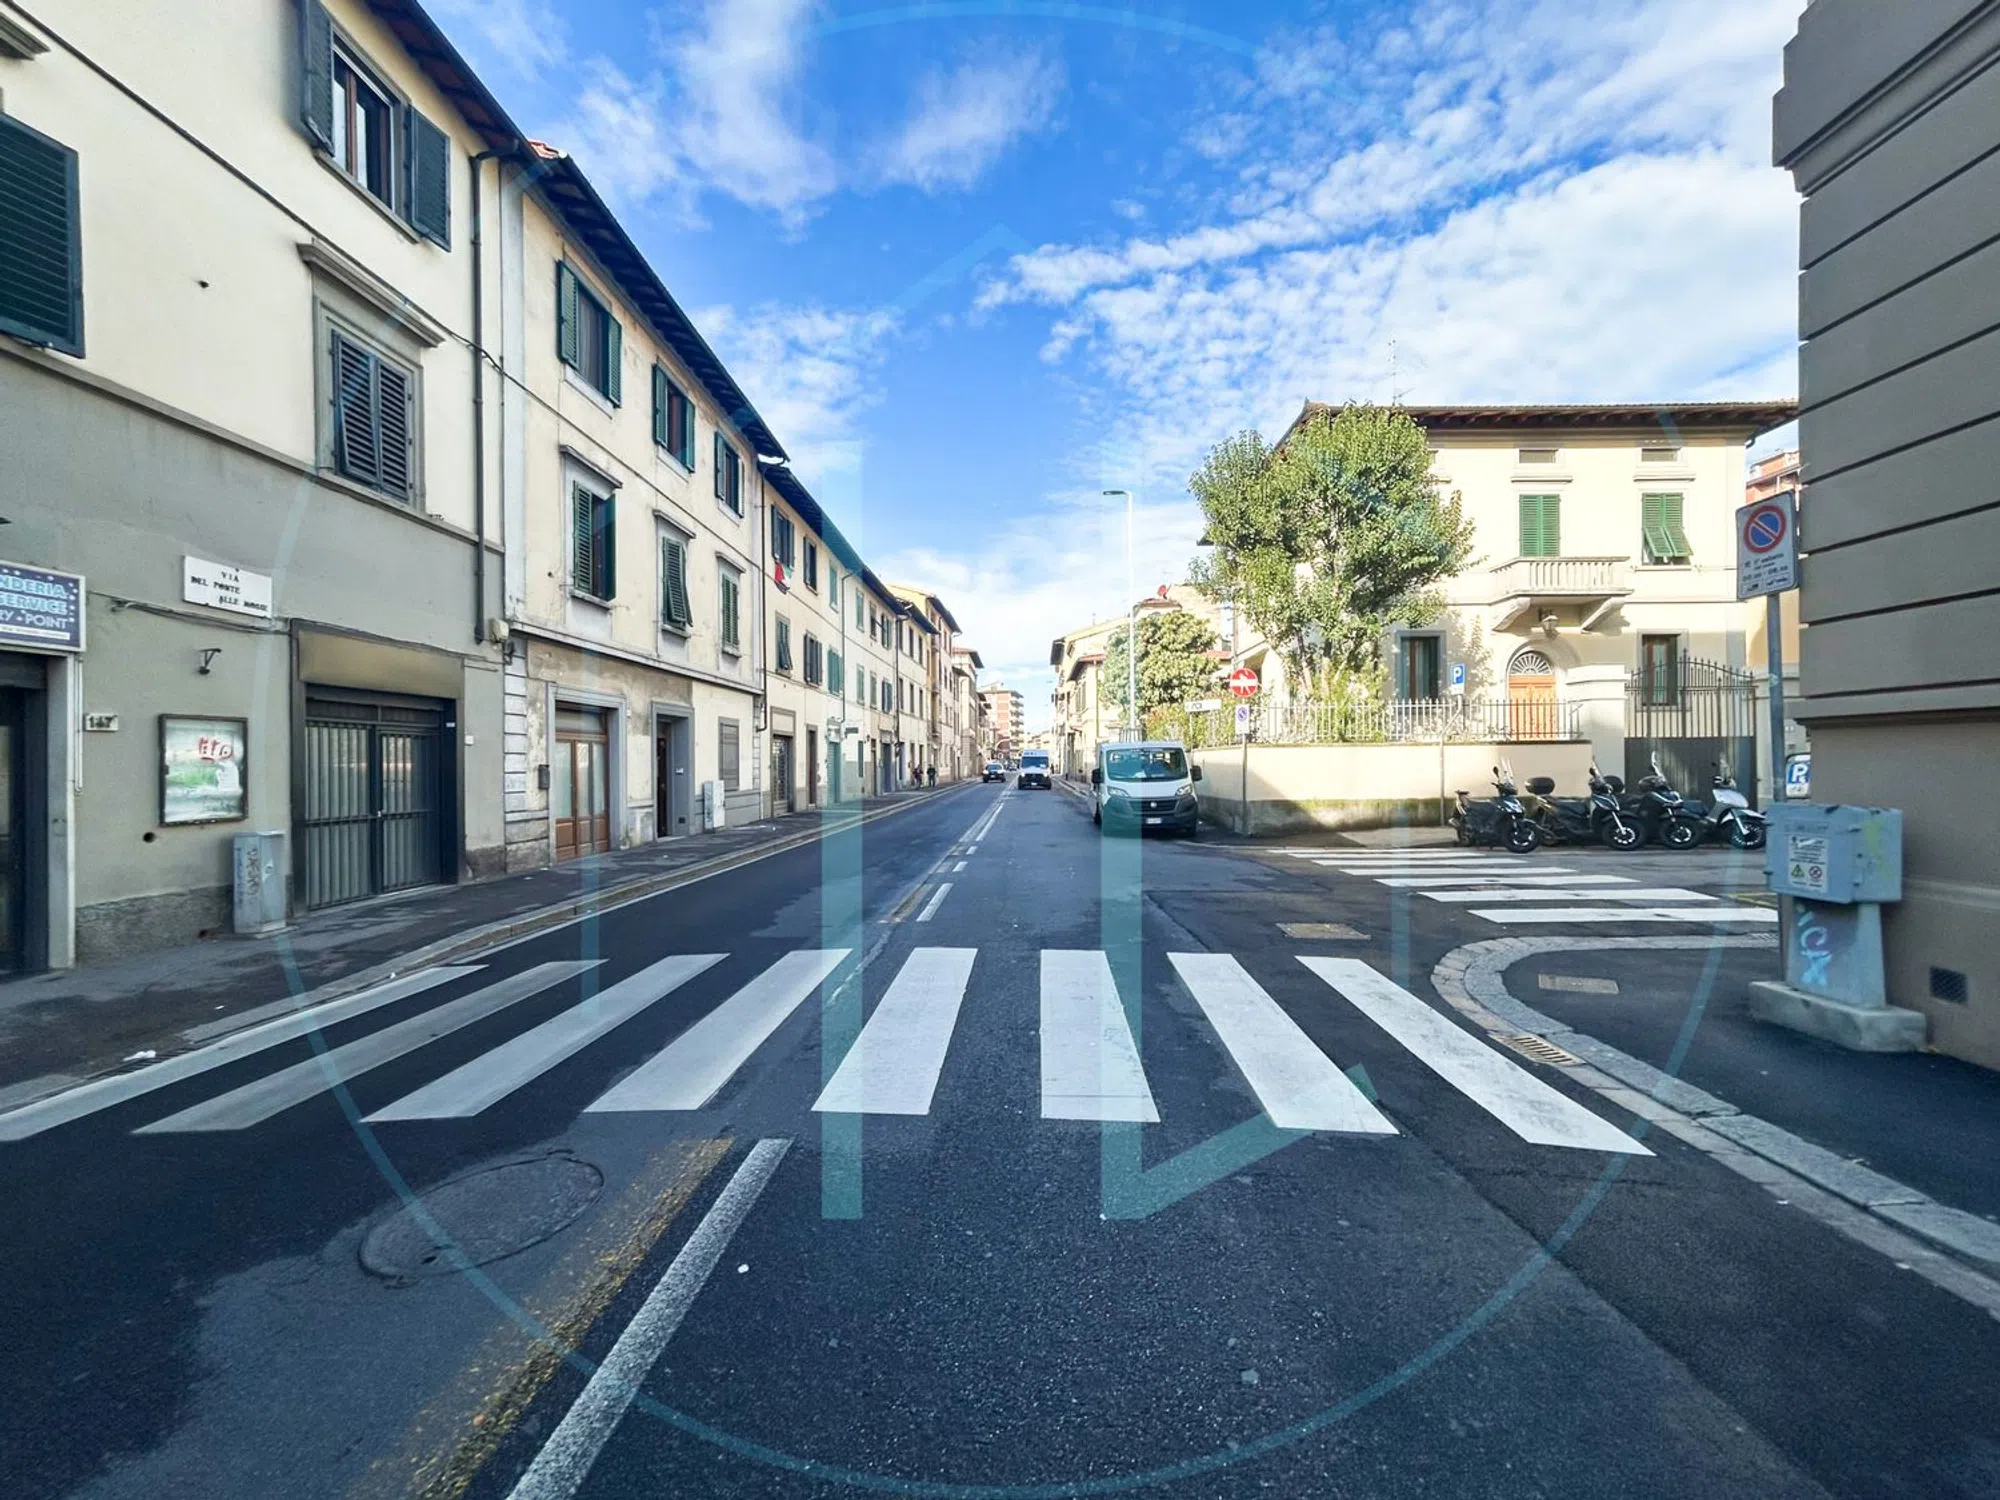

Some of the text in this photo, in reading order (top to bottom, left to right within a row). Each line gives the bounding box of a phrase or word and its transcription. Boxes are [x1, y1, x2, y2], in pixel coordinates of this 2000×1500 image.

[190, 575, 240, 595] DEL PONTE
[221, 571, 240, 583] VIA
[25, 613, 68, 630] POINT
[1453, 666, 1463, 683] P
[1791, 763, 1808, 782] P
